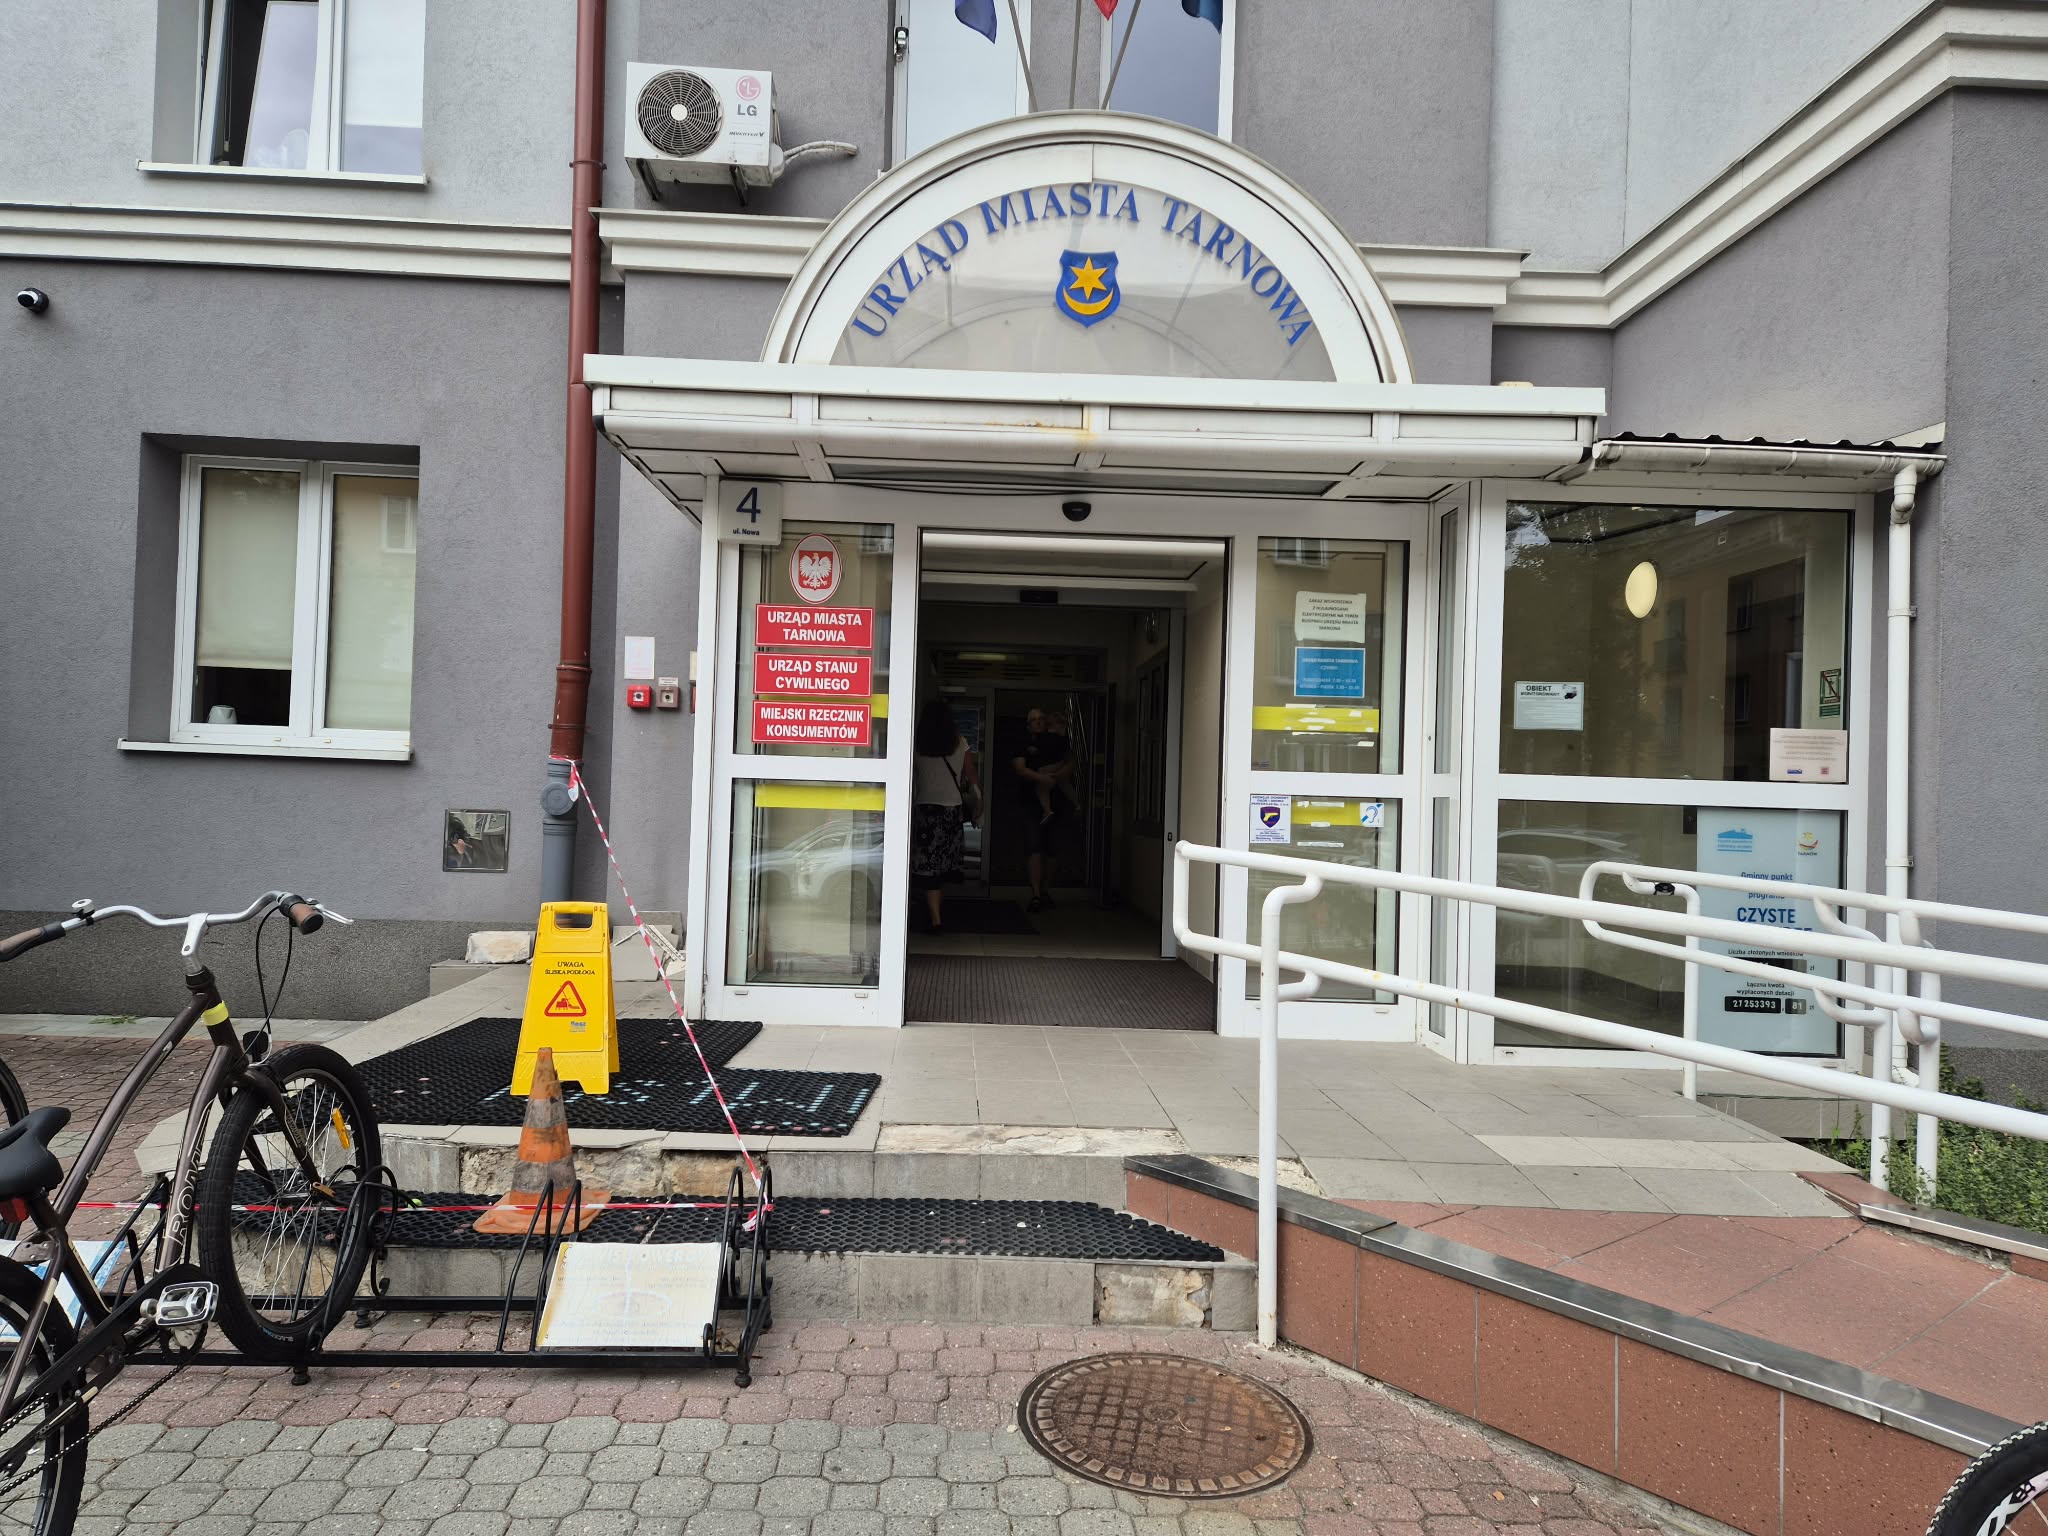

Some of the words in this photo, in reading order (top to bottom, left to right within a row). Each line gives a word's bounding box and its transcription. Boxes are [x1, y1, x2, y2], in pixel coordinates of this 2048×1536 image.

[737, 104, 757, 116] LG
[852, 219, 969, 337] URZĄD
[979, 183, 1140, 235] MIASTA
[1162, 196, 1313, 346] TARNOWA
[736, 487, 761, 523] 4
[767, 611, 811, 626] URZĄD
[813, 612, 863, 626] MIASTA
[783, 628, 846, 642] TARNOWA
[769, 659, 812, 675] URZĄD
[815, 661, 858, 674] STANU
[775, 677, 850, 690] CYWILNEGO
[760, 707, 806, 720] MIEJSKI
[809, 708, 864, 722] RZECZNIK
[766, 724, 858, 738] KONSUMENTÓW
[1737, 907, 1796, 923] CZYSTE
